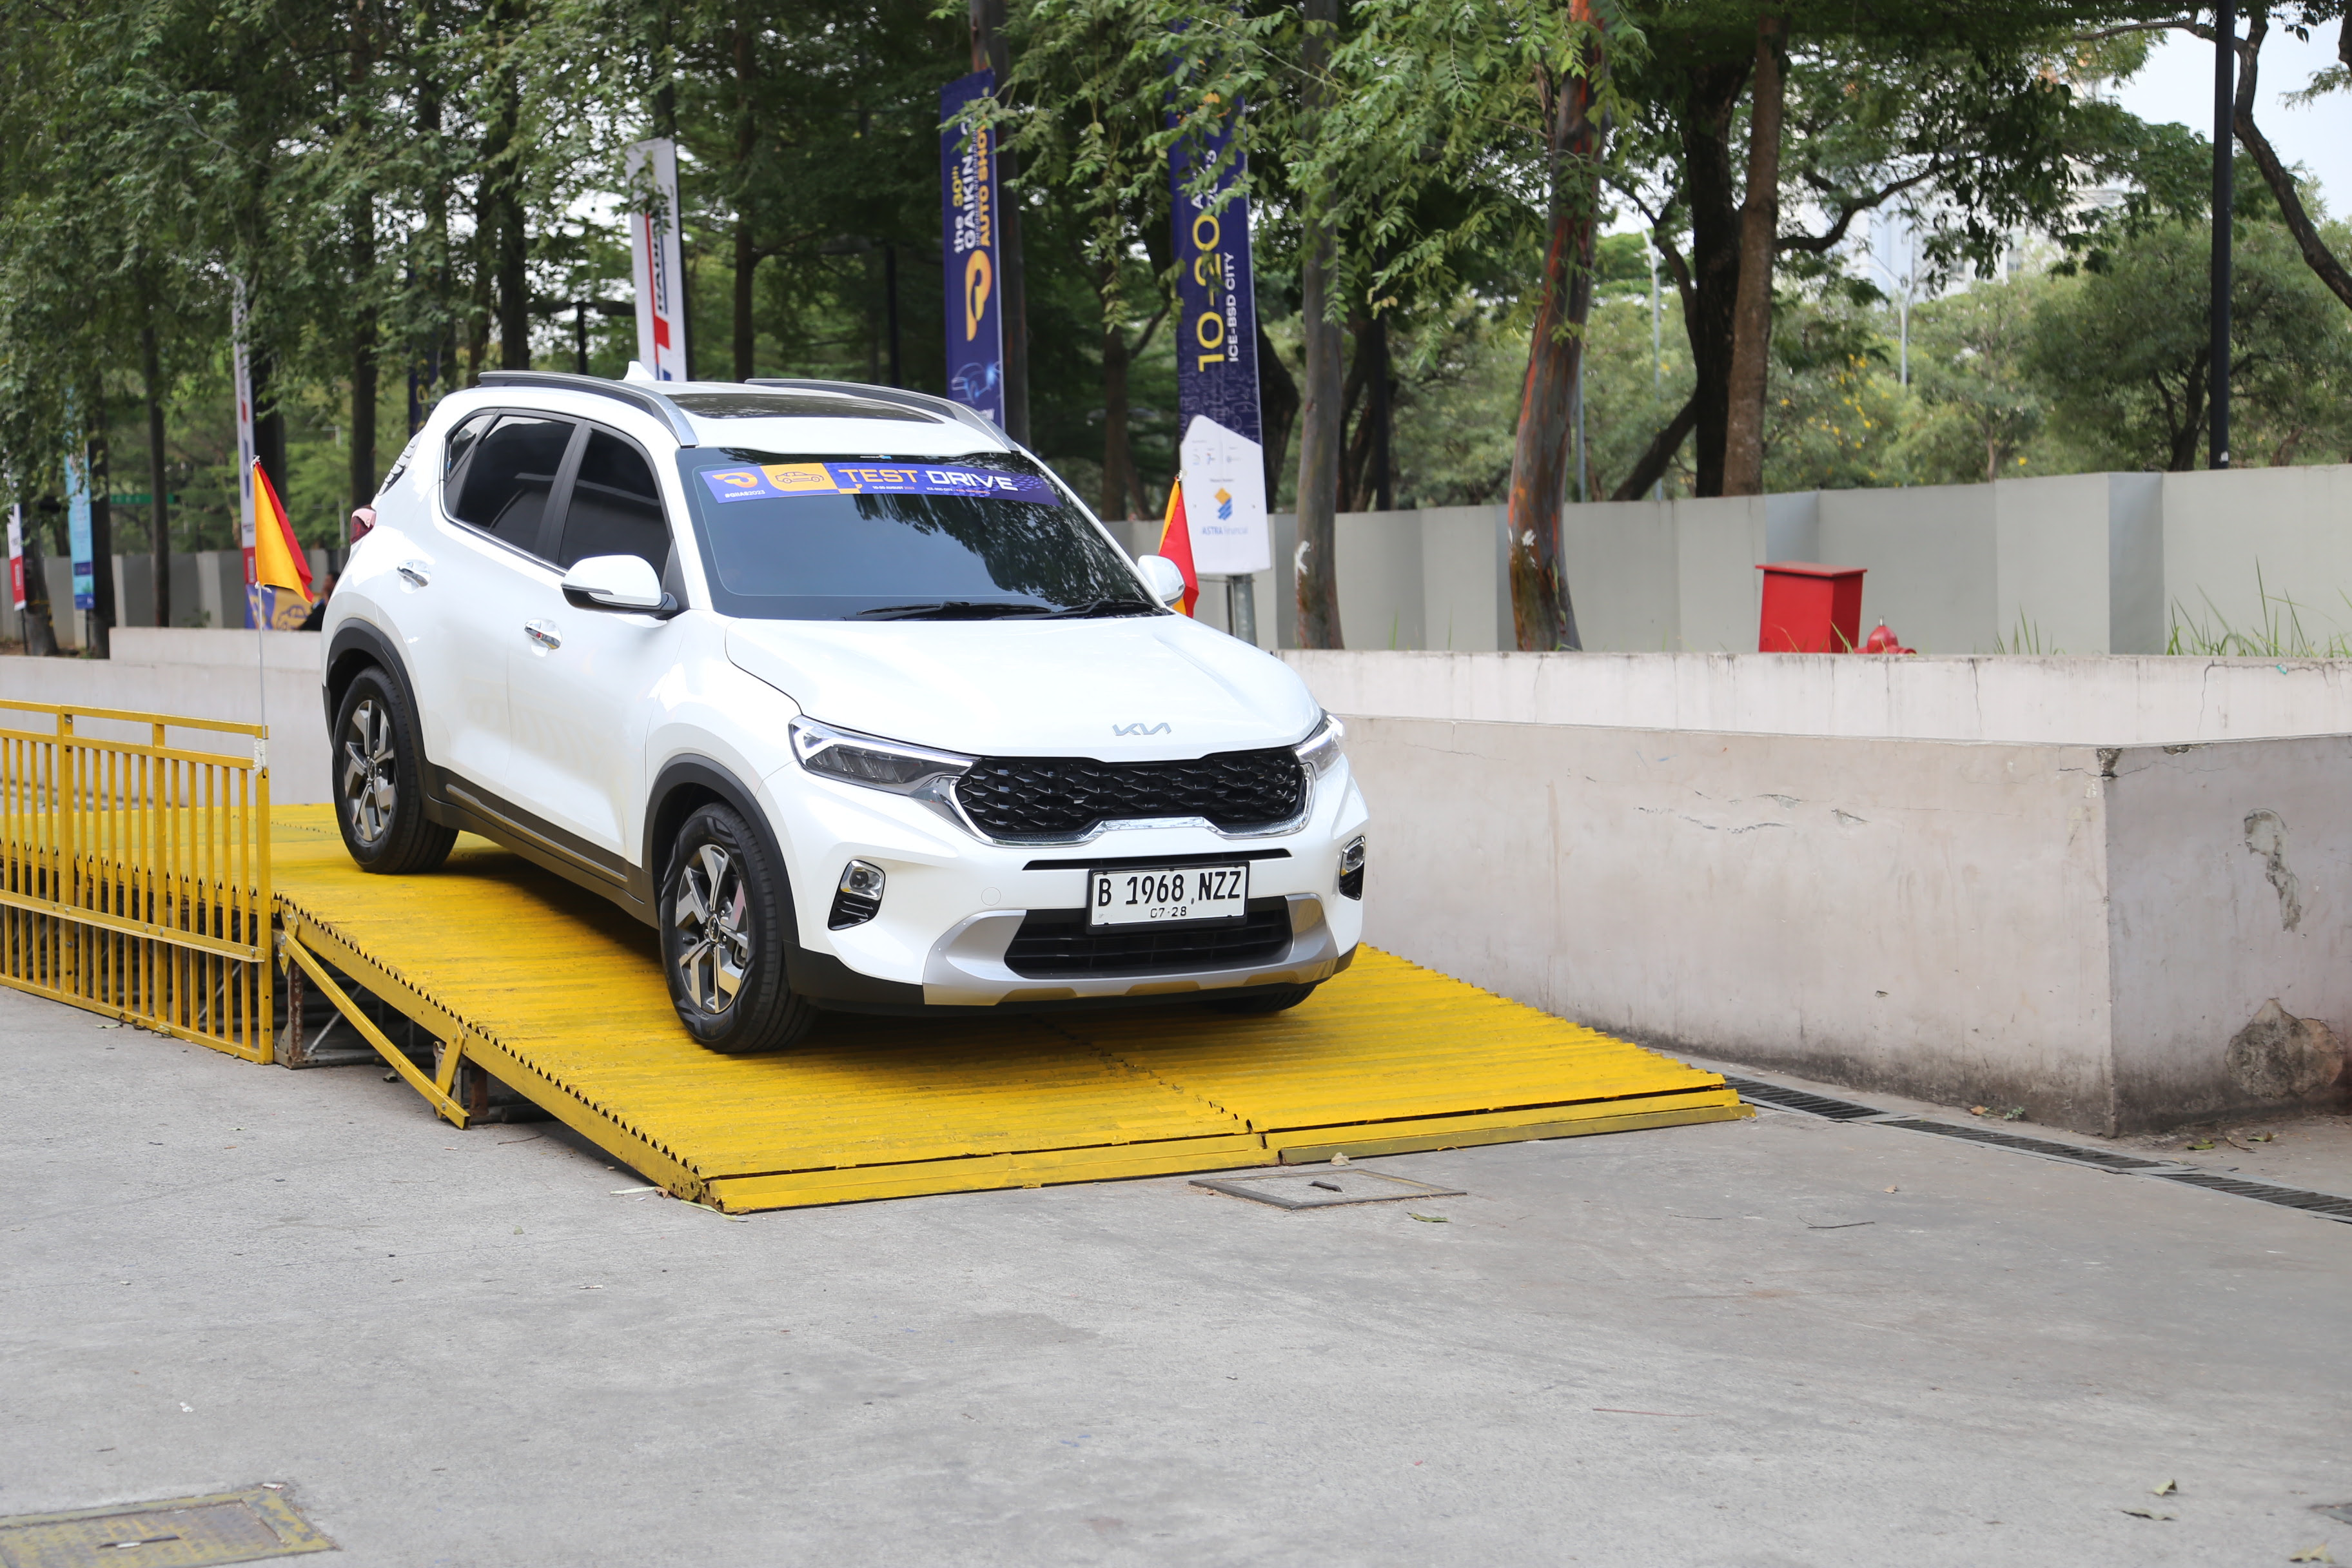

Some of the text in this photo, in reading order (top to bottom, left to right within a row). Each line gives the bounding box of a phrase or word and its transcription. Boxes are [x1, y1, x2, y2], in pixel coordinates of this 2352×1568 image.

[961, 119, 976, 250] GAIKIN
[954, 215, 965, 254] the
[979, 185, 990, 247] AUTO
[1193, 214, 1224, 372] 10-20
[1224, 252, 1239, 362] ICE-BSD CITY
[725, 489, 765, 498] #GIIAS2023
[838, 469, 1019, 491] TEST DRIVE
[1098, 871, 1242, 906] B 1968 NZZ
